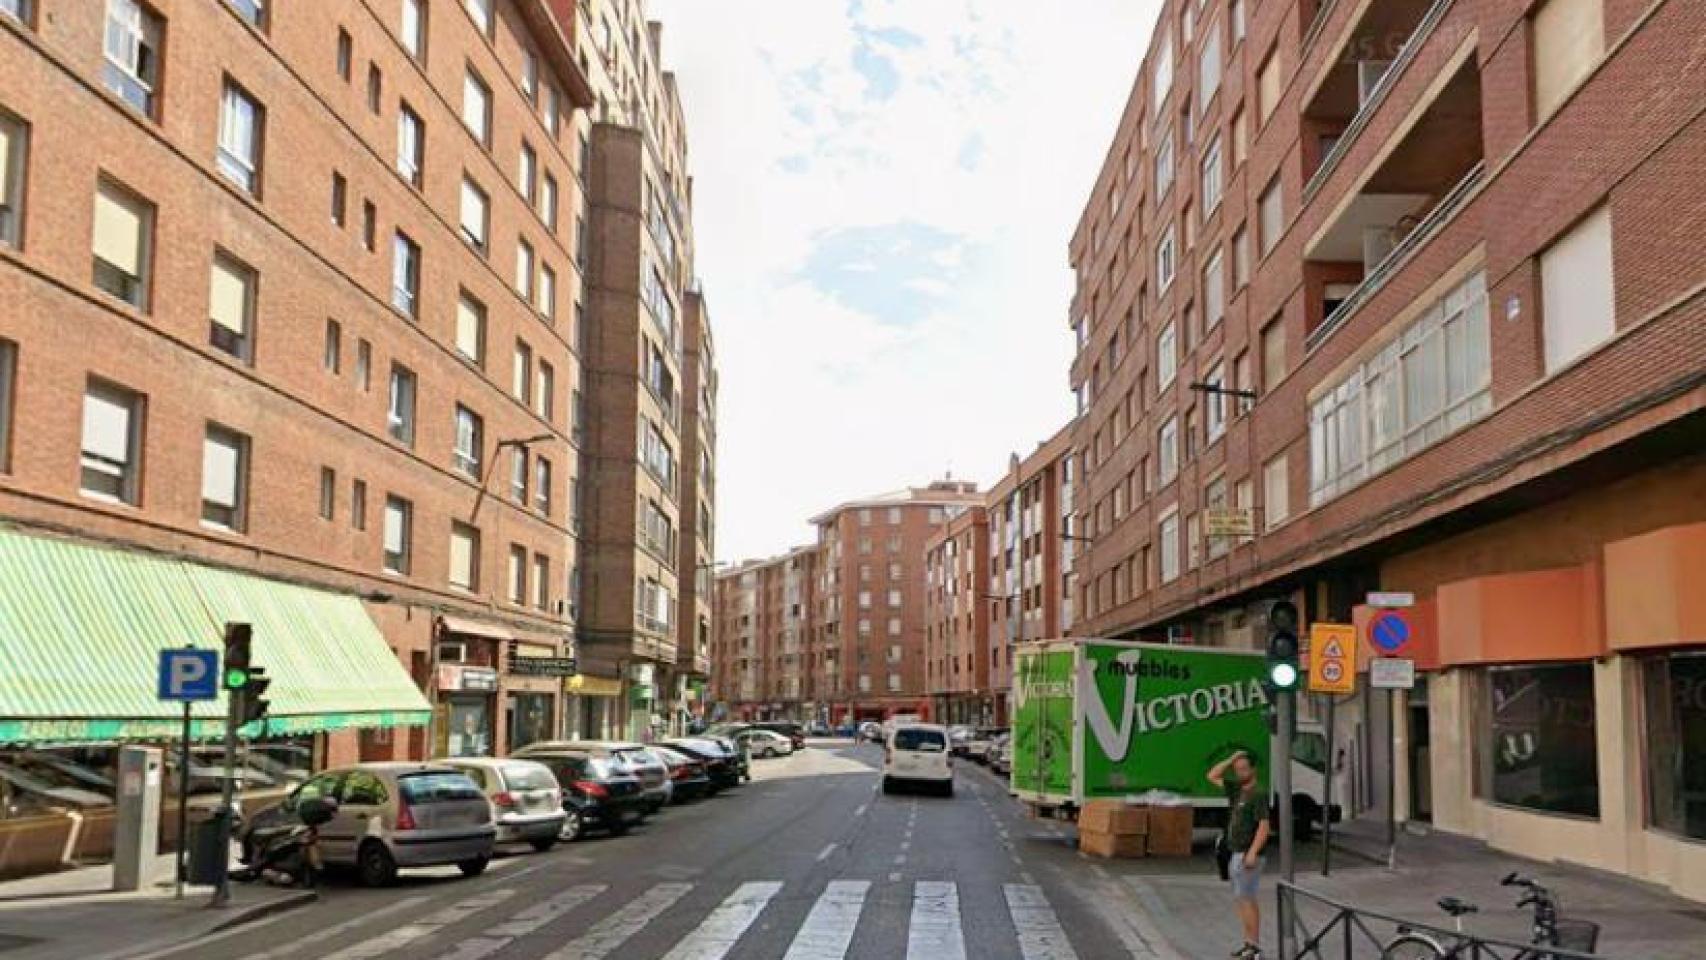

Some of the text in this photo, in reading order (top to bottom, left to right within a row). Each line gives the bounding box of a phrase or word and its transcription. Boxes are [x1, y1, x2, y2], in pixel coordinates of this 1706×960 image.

[170, 655, 206, 694] P
[1108, 658, 1191, 680] muebles
[1077, 649, 1269, 762] VICTORIA
